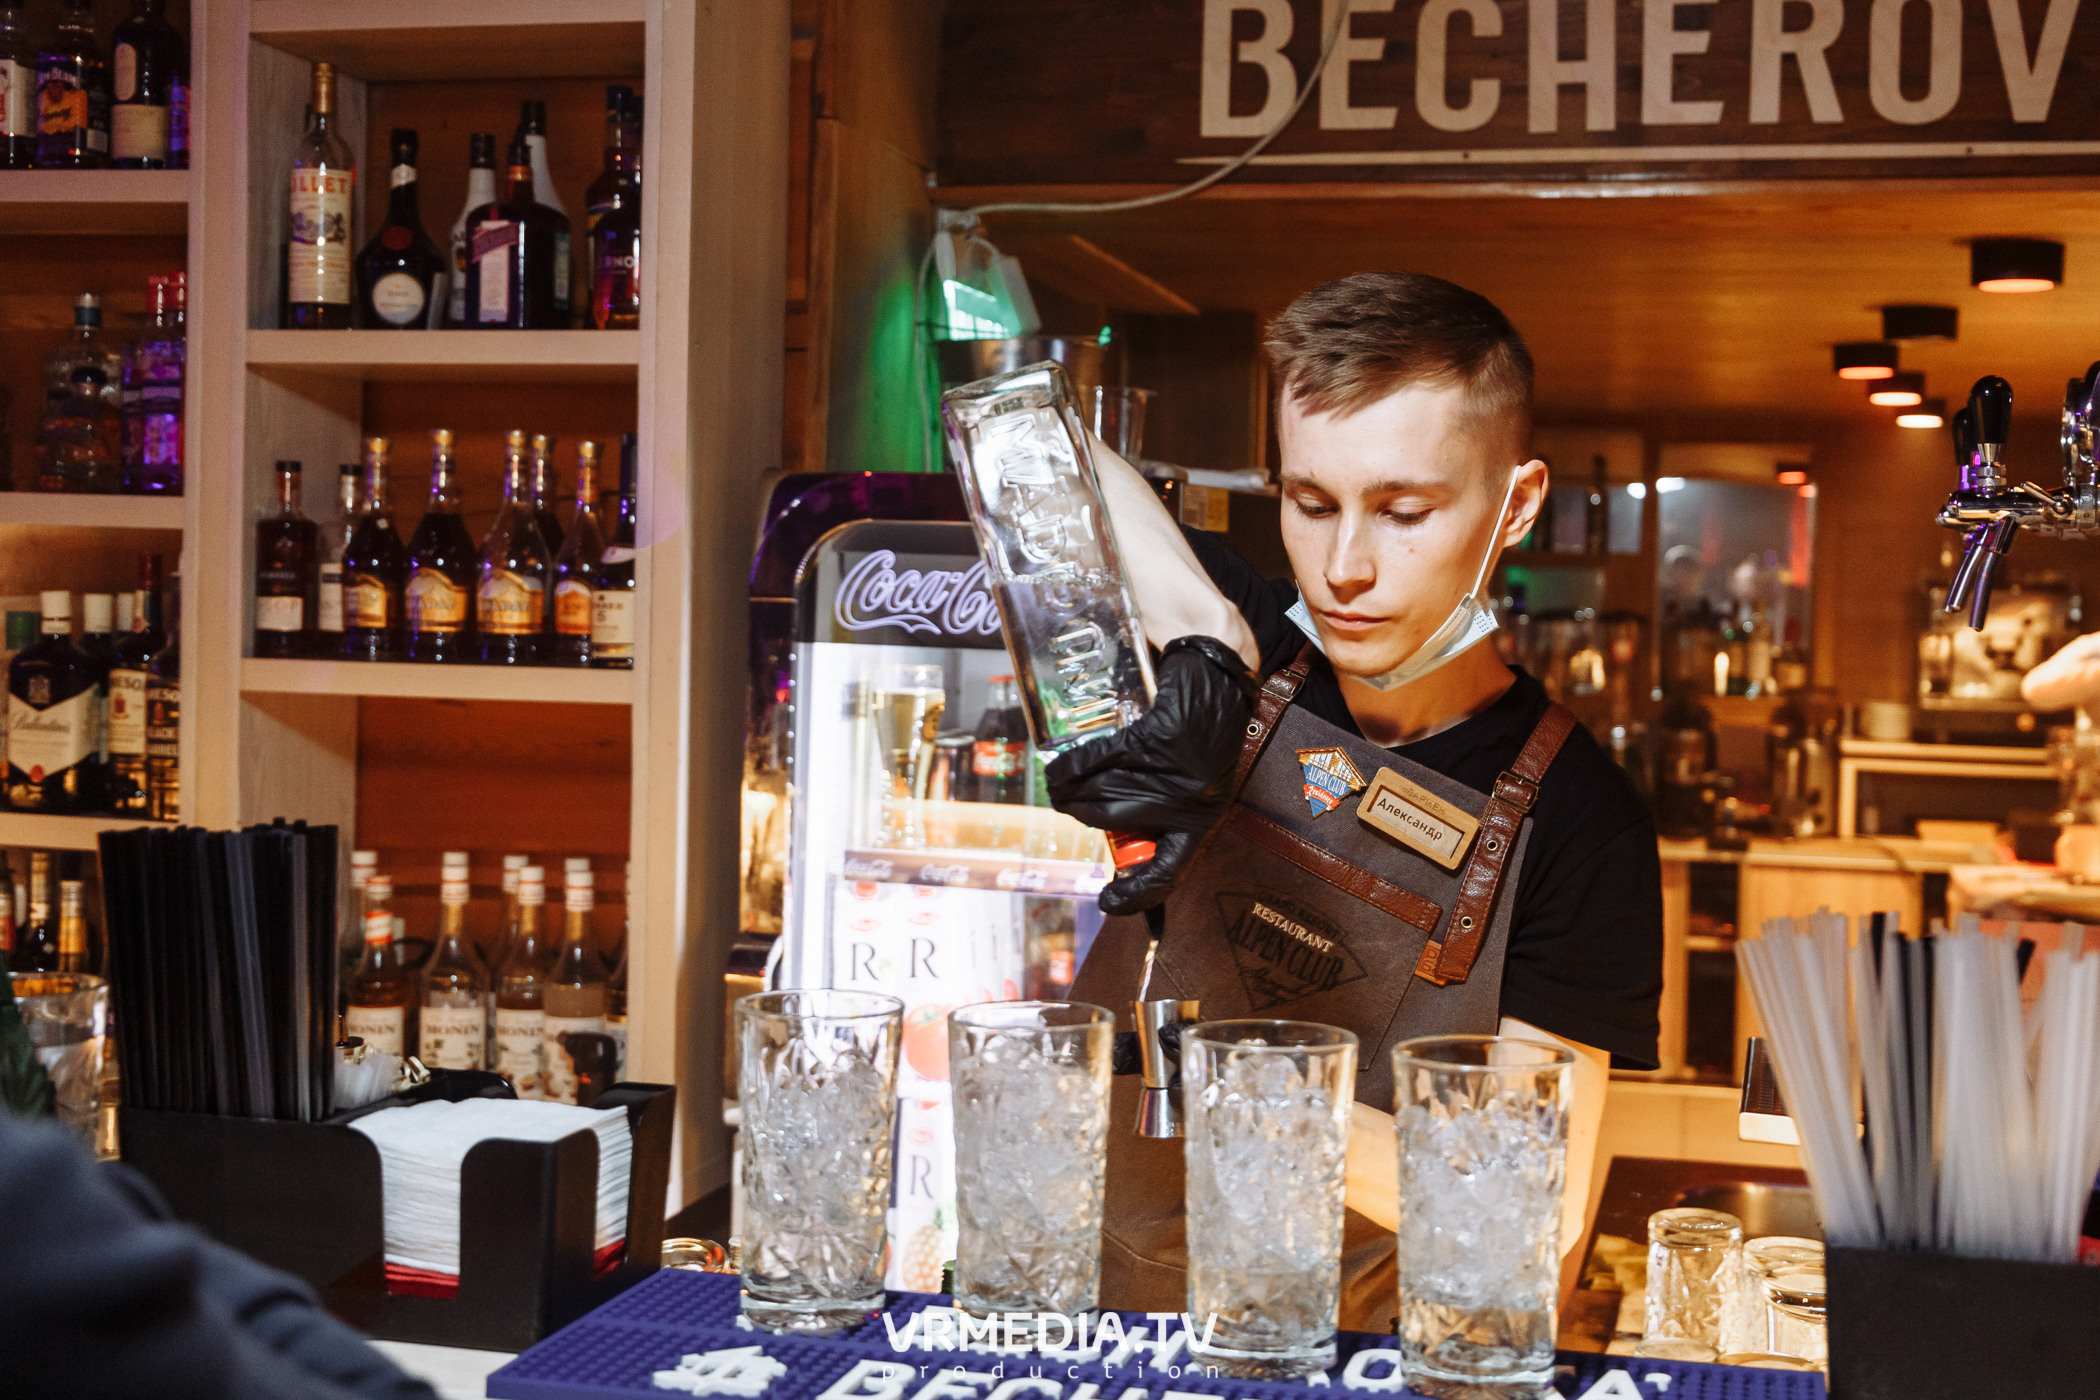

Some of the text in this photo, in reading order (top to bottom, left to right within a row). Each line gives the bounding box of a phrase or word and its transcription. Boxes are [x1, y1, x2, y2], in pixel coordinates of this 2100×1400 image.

[292, 176, 348, 194] ILLET
[836, 549, 1002, 636] Coca-Co
[1306, 765, 1347, 796] ALPEN CLUB
[1377, 797, 1443, 841] Александр
[1226, 907, 1297, 967] ALPEN
[1286, 944, 1344, 991] CLUB
[1250, 901, 1336, 953] RESTAURANT
